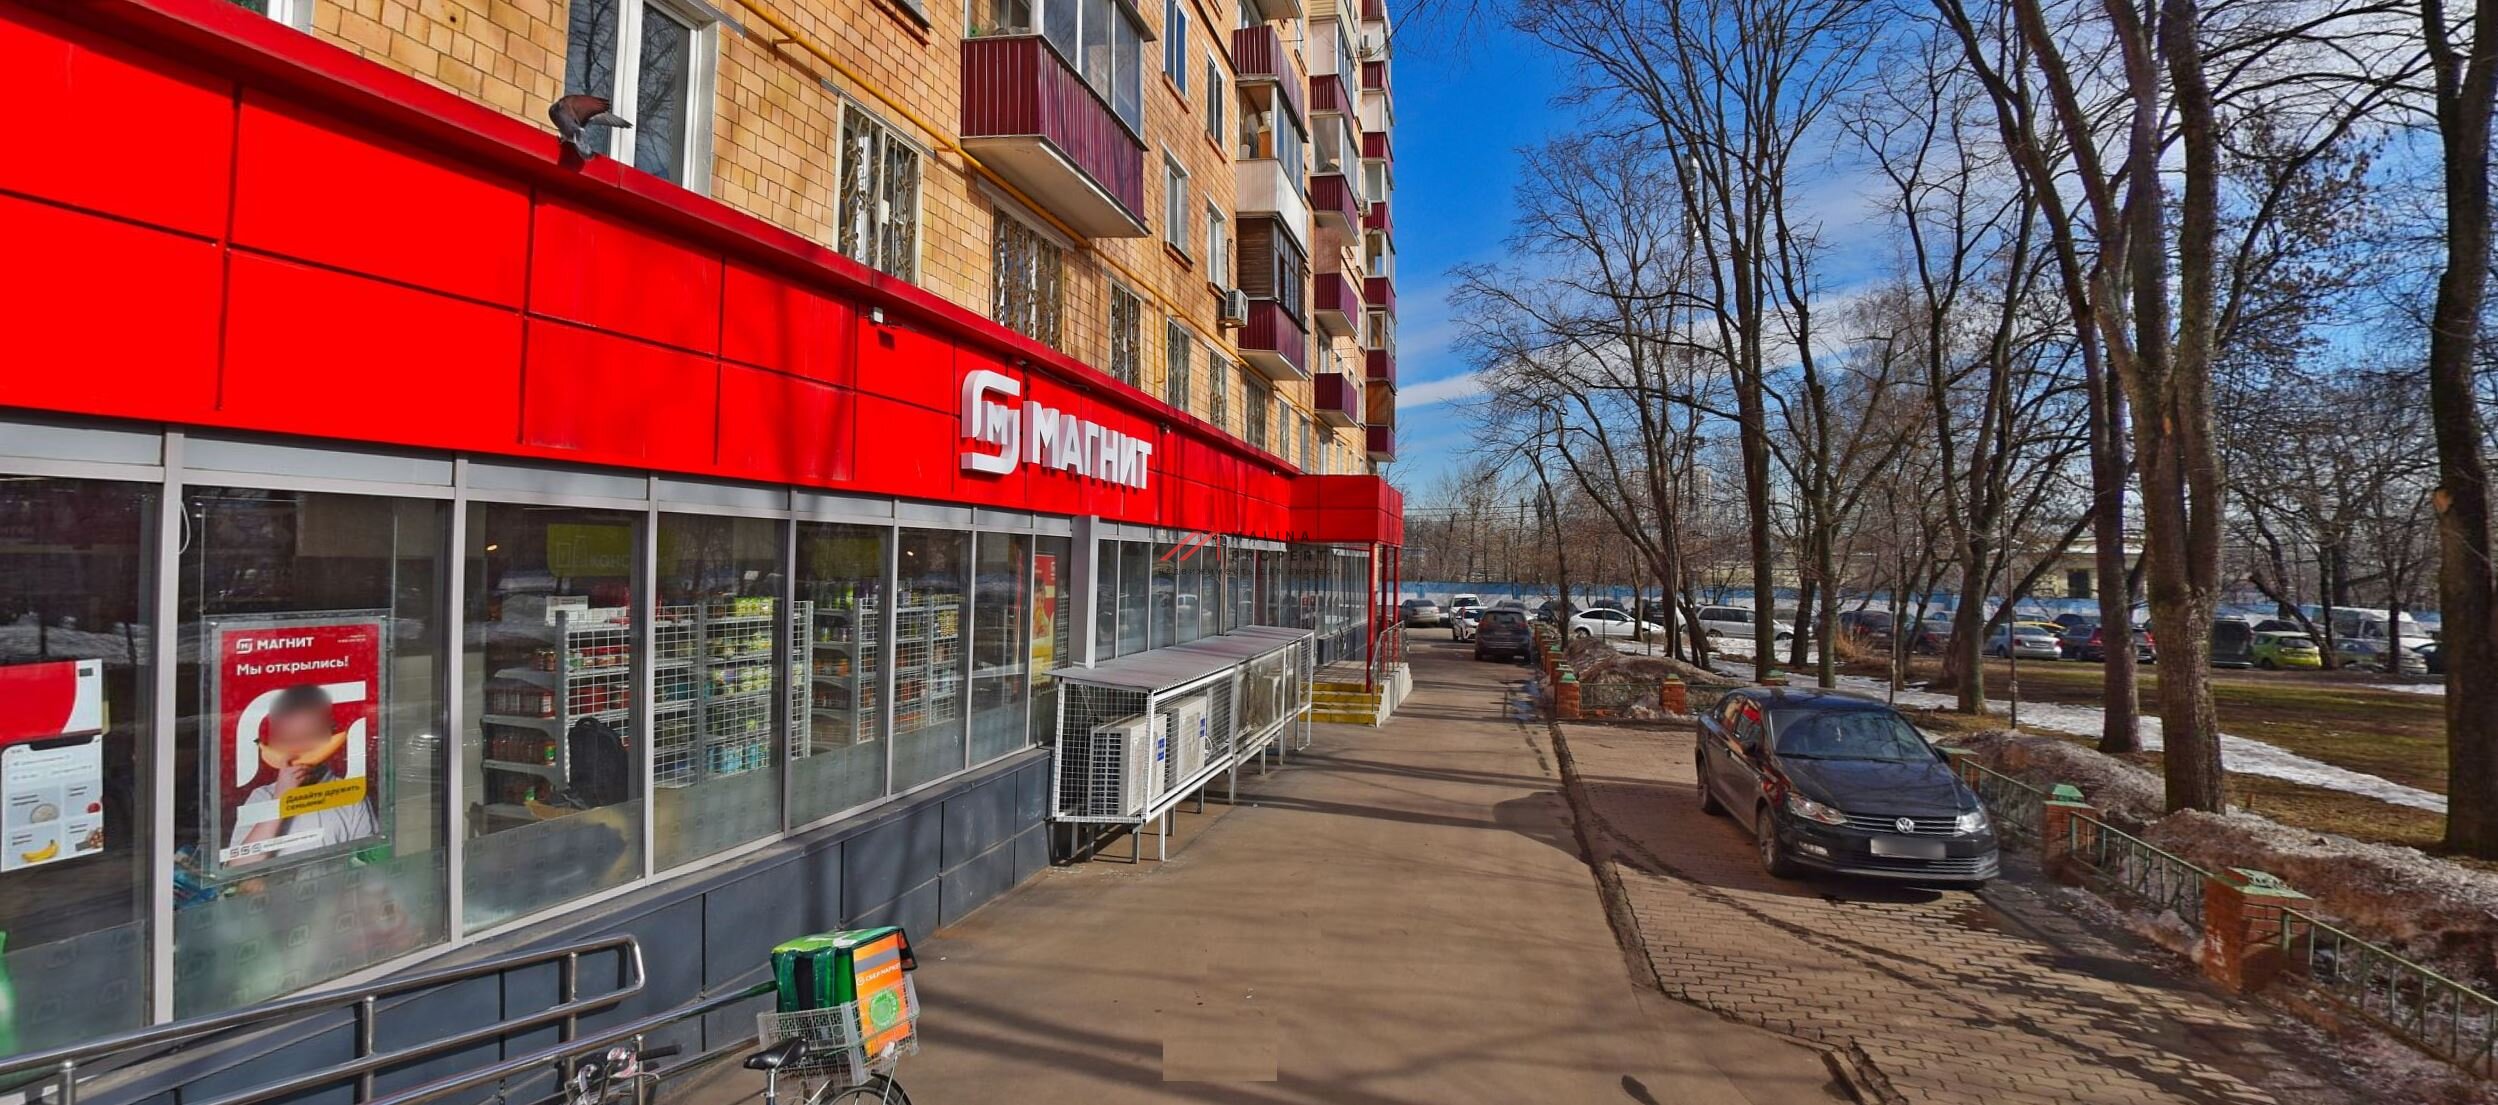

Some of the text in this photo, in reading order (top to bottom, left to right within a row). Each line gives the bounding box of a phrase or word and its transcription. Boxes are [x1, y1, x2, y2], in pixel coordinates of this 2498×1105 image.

[1023, 400, 1152, 489] МАГНИТ
[256, 636, 315, 650] МАГНИТ
[236, 655, 350, 676] Мы открылись!
[324, 785, 361, 798] дружить
